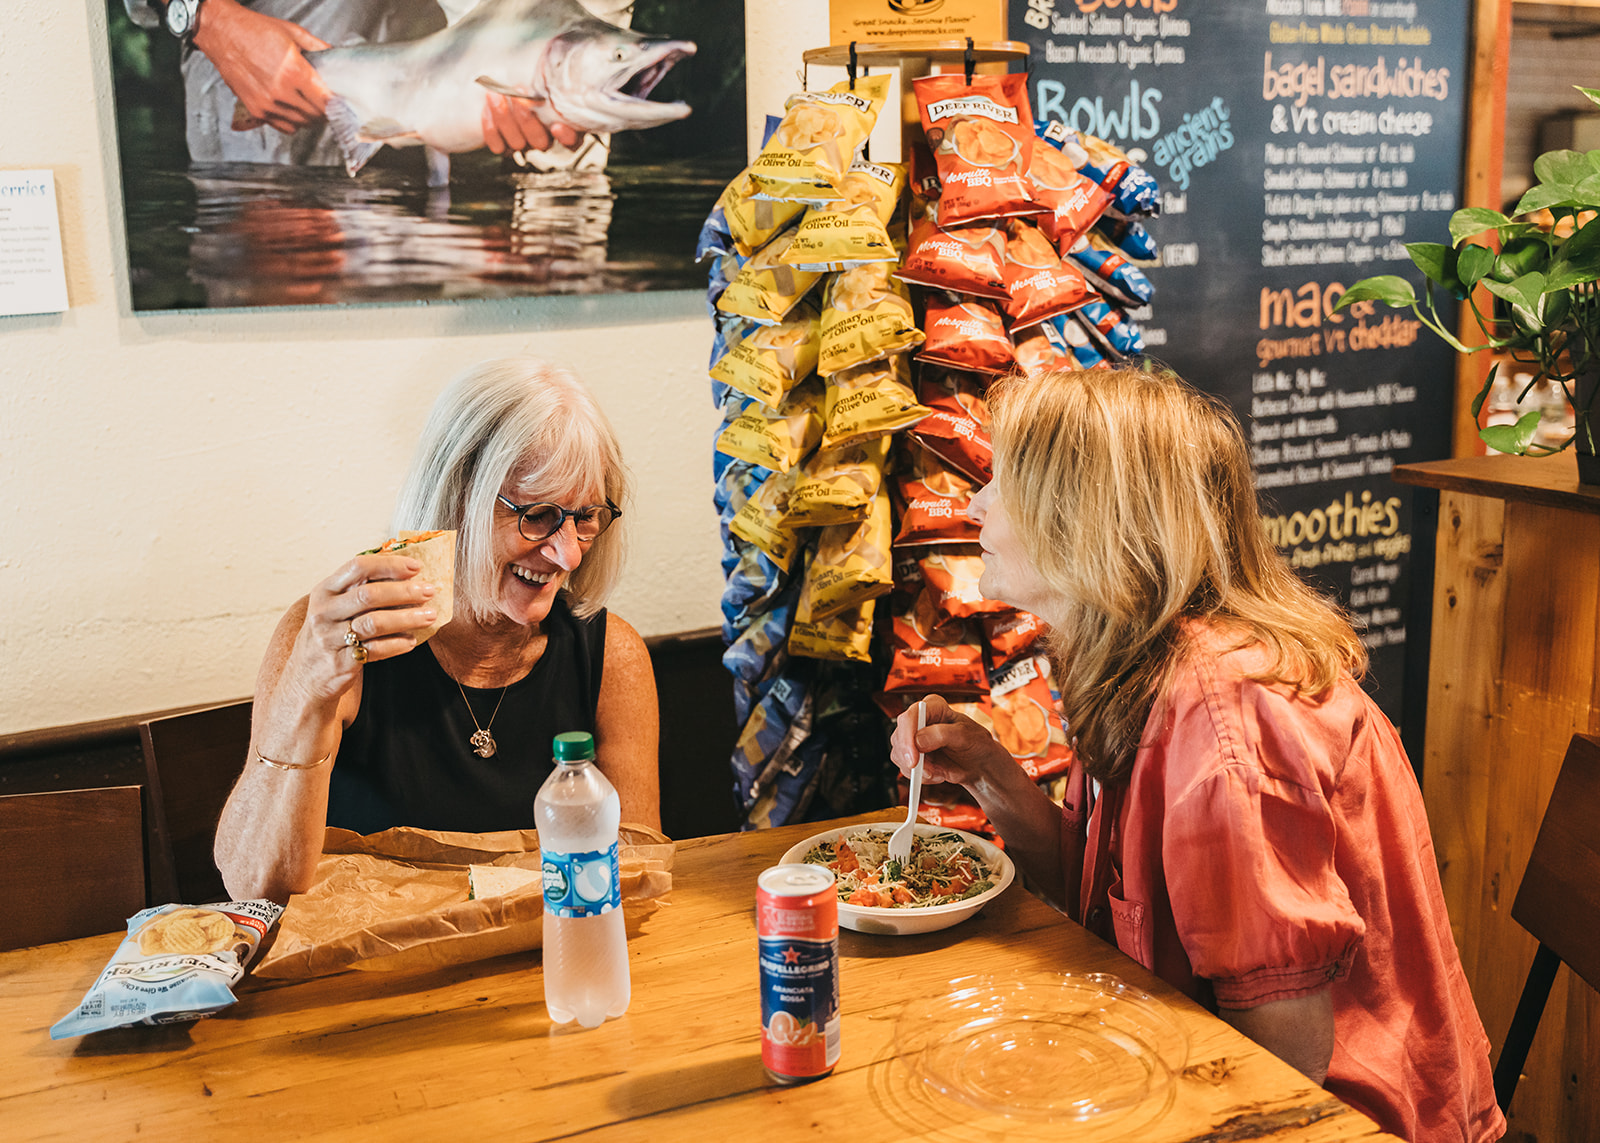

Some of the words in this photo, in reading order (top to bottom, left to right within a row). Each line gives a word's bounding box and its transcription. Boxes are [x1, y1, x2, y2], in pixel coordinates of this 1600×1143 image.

[1263, 51, 1325, 107] bagel
[1328, 55, 1450, 101] sandwiches
[933, 101, 969, 115] DEEP
[971, 102, 1014, 120] RIVER
[1270, 104, 1289, 134] &
[1322, 109, 1377, 135] cream
[1378, 105, 1433, 136] cheese
[1152, 96, 1230, 167] ancient
[763, 159, 786, 167] Olive
[788, 159, 801, 167] Oil
[1169, 121, 1234, 191] grains
[0, 180, 46, 196] erries
[966, 177, 992, 187] BBQ
[806, 221, 831, 230] Olive
[834, 219, 849, 228] Oil
[938, 247, 963, 259] BBQ
[1010, 270, 1052, 294] Mesquite
[1260, 281, 1346, 330] mac
[834, 323, 858, 336] Olive
[860, 315, 874, 326] Oil
[959, 326, 984, 336] BBQ
[1256, 332, 1321, 368] gourmet
[1349, 314, 1422, 351] cheddar
[837, 401, 860, 414] Olive
[862, 392, 877, 404] Oil
[953, 424, 974, 441] BBQ
[817, 488, 829, 496] Oil
[929, 507, 952, 518] BBQ
[1263, 489, 1402, 548] moothies
[996, 662, 1033, 685] RIVER
